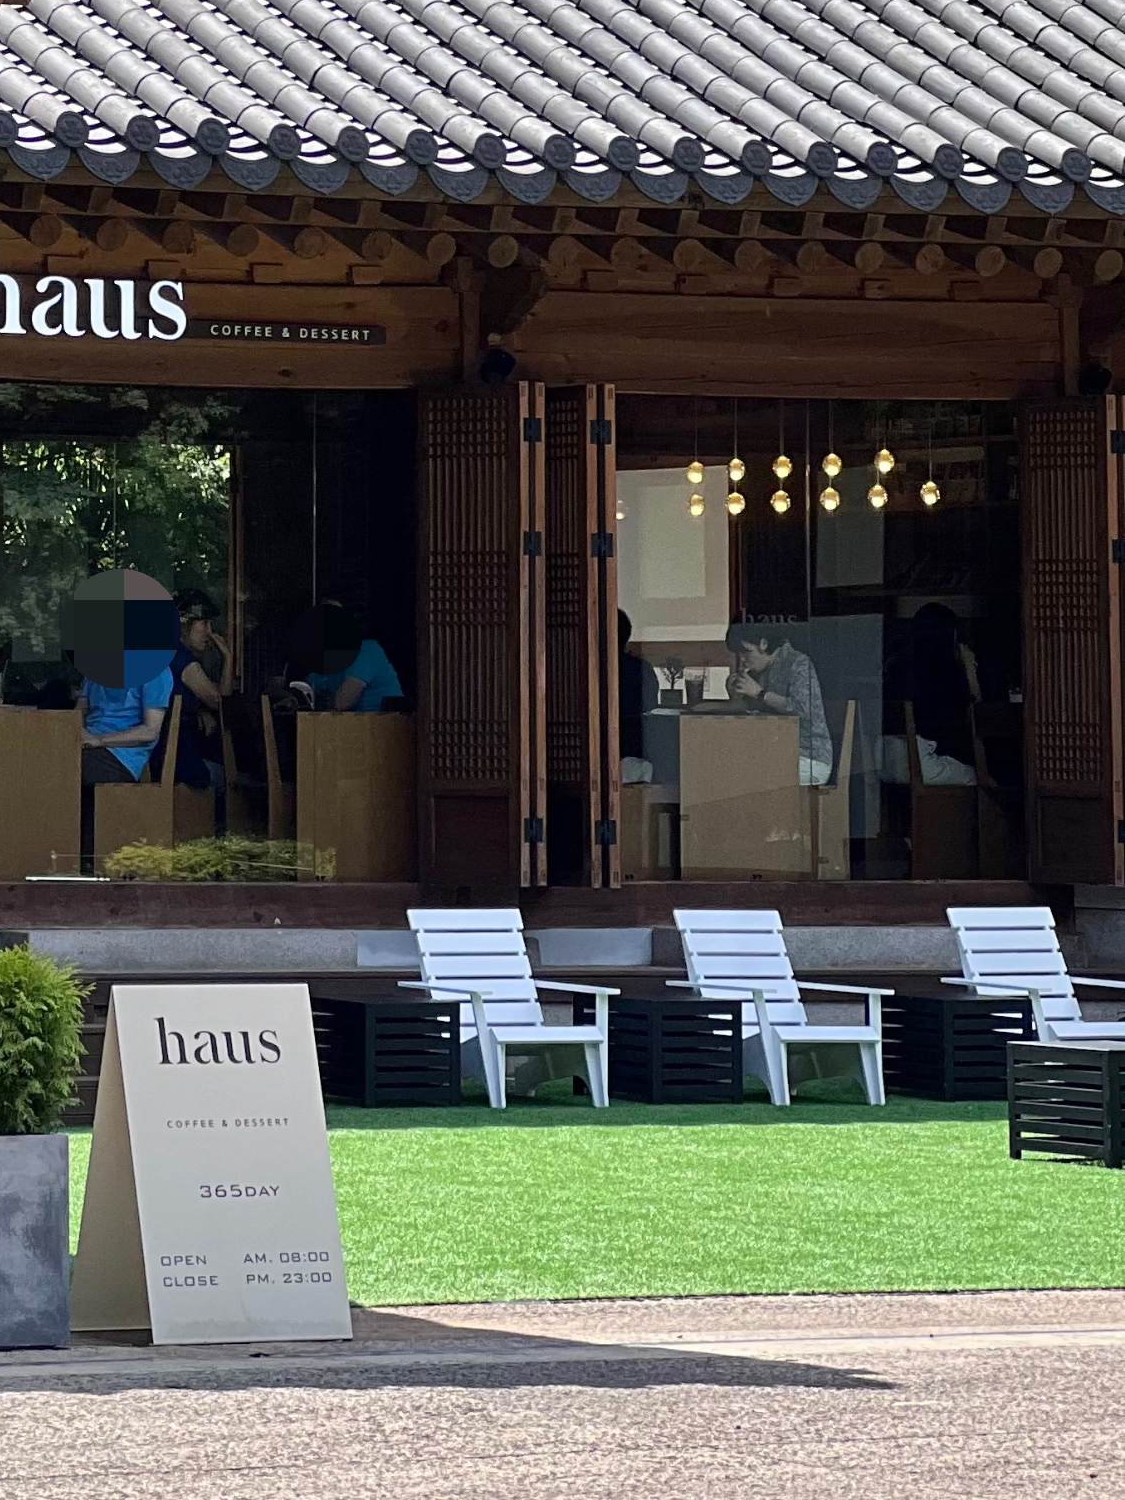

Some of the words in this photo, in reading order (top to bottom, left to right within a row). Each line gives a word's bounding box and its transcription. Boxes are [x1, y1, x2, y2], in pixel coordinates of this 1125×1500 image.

[210, 324, 273, 338] COFFEE
[281, 327, 290, 338] &
[299, 328, 370, 341] DESSERT
[154, 1016, 282, 1065] haus
[166, 1119, 215, 1128] COFFEE
[221, 1119, 228, 1127] &
[234, 1117, 289, 1127] DESSERT
[199, 1184, 280, 1199] 365DAY
[160, 1255, 207, 1267] OPEN
[243, 1253, 273, 1264] AM.
[279, 1251, 330, 1263] 08:00
[163, 1275, 220, 1288] CLOSE
[246, 1274, 276, 1285] PM.
[282, 1272, 332, 1284] 23:00
